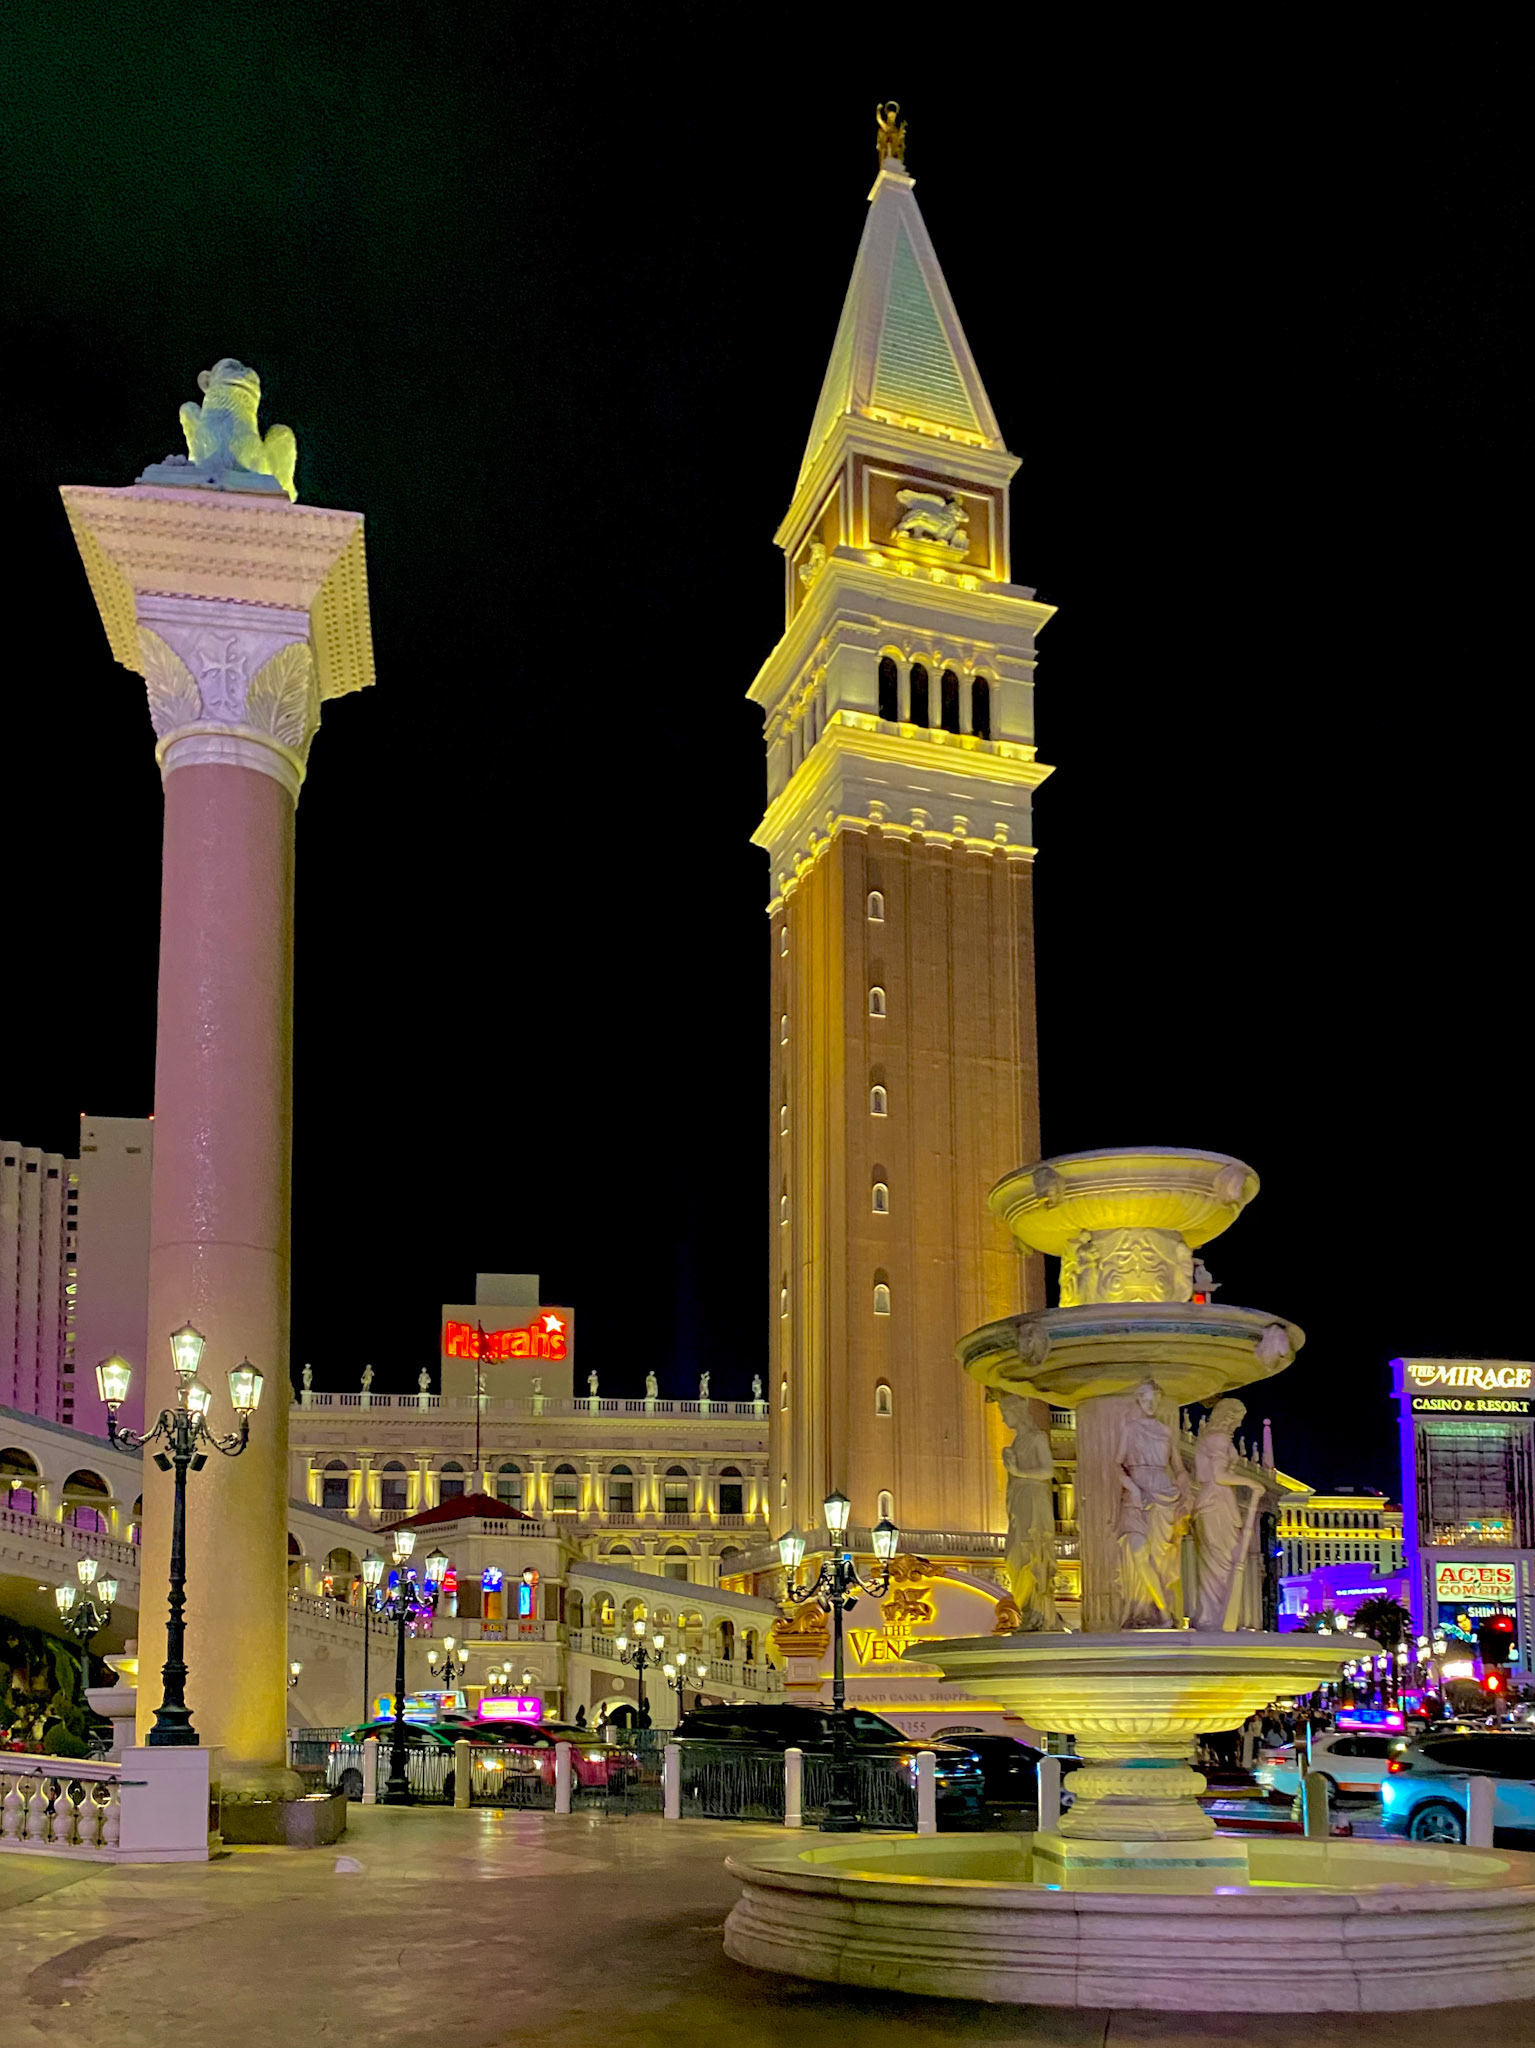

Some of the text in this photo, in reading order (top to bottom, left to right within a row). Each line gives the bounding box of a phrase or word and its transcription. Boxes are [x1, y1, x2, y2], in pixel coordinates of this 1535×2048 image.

[446, 1321, 567, 1360] Harahs
[1407, 1365, 1532, 1391] THE MIRAGE
[1412, 1398, 1530, 1413] CASINO & RESORT
[1438, 1567, 1514, 1585] ACES
[1438, 1585, 1513, 1596] COMEDY
[1467, 1606, 1495, 1618] SHIN
[882, 1625, 912, 1637] THE
[848, 1693, 886, 1702] GRAND
[890, 1693, 926, 1702] CANAL
